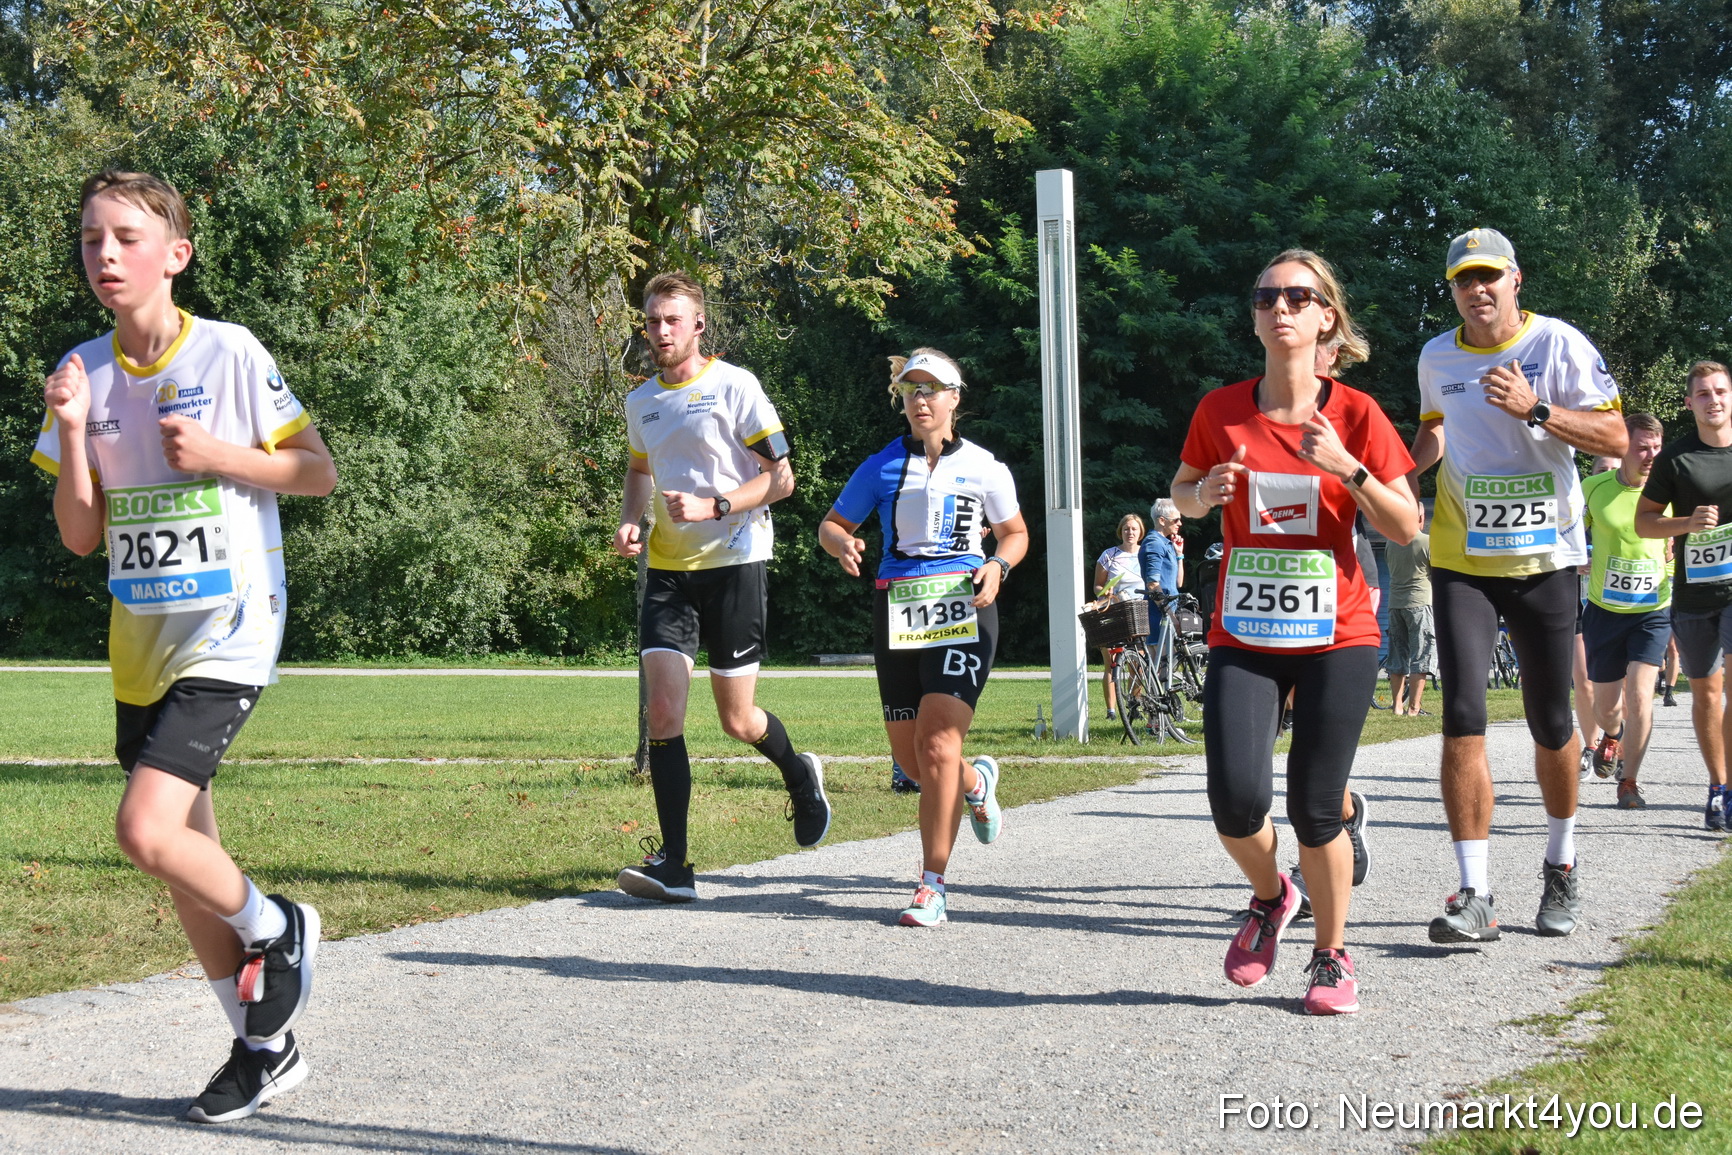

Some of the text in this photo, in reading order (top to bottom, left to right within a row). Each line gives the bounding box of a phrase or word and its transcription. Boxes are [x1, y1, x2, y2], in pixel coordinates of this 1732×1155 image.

[158, 384, 177, 403] 20
[689, 393, 701, 402] 20
[158, 398, 213, 414] Neumarkter
[686, 407, 712, 415] Stadtlauf
[1470, 476, 1549, 497] BOCK
[111, 485, 212, 521] BOCK
[1272, 509, 1295, 520] DEHN
[1474, 502, 1547, 528] 2225
[119, 526, 208, 570] 2621
[1485, 534, 1535, 547] BERND
[1234, 552, 1327, 576] BOCK
[1611, 559, 1656, 573] BOCK
[131, 578, 198, 600] MARCO
[895, 579, 968, 601] BOCK
[1610, 573, 1653, 590] 2675
[1236, 582, 1319, 613] 2561
[901, 601, 966, 627] 1138
[899, 626, 969, 641] FRANZISKA
[1237, 621, 1318, 635] SUSANNE
[943, 649, 981, 687] BR
